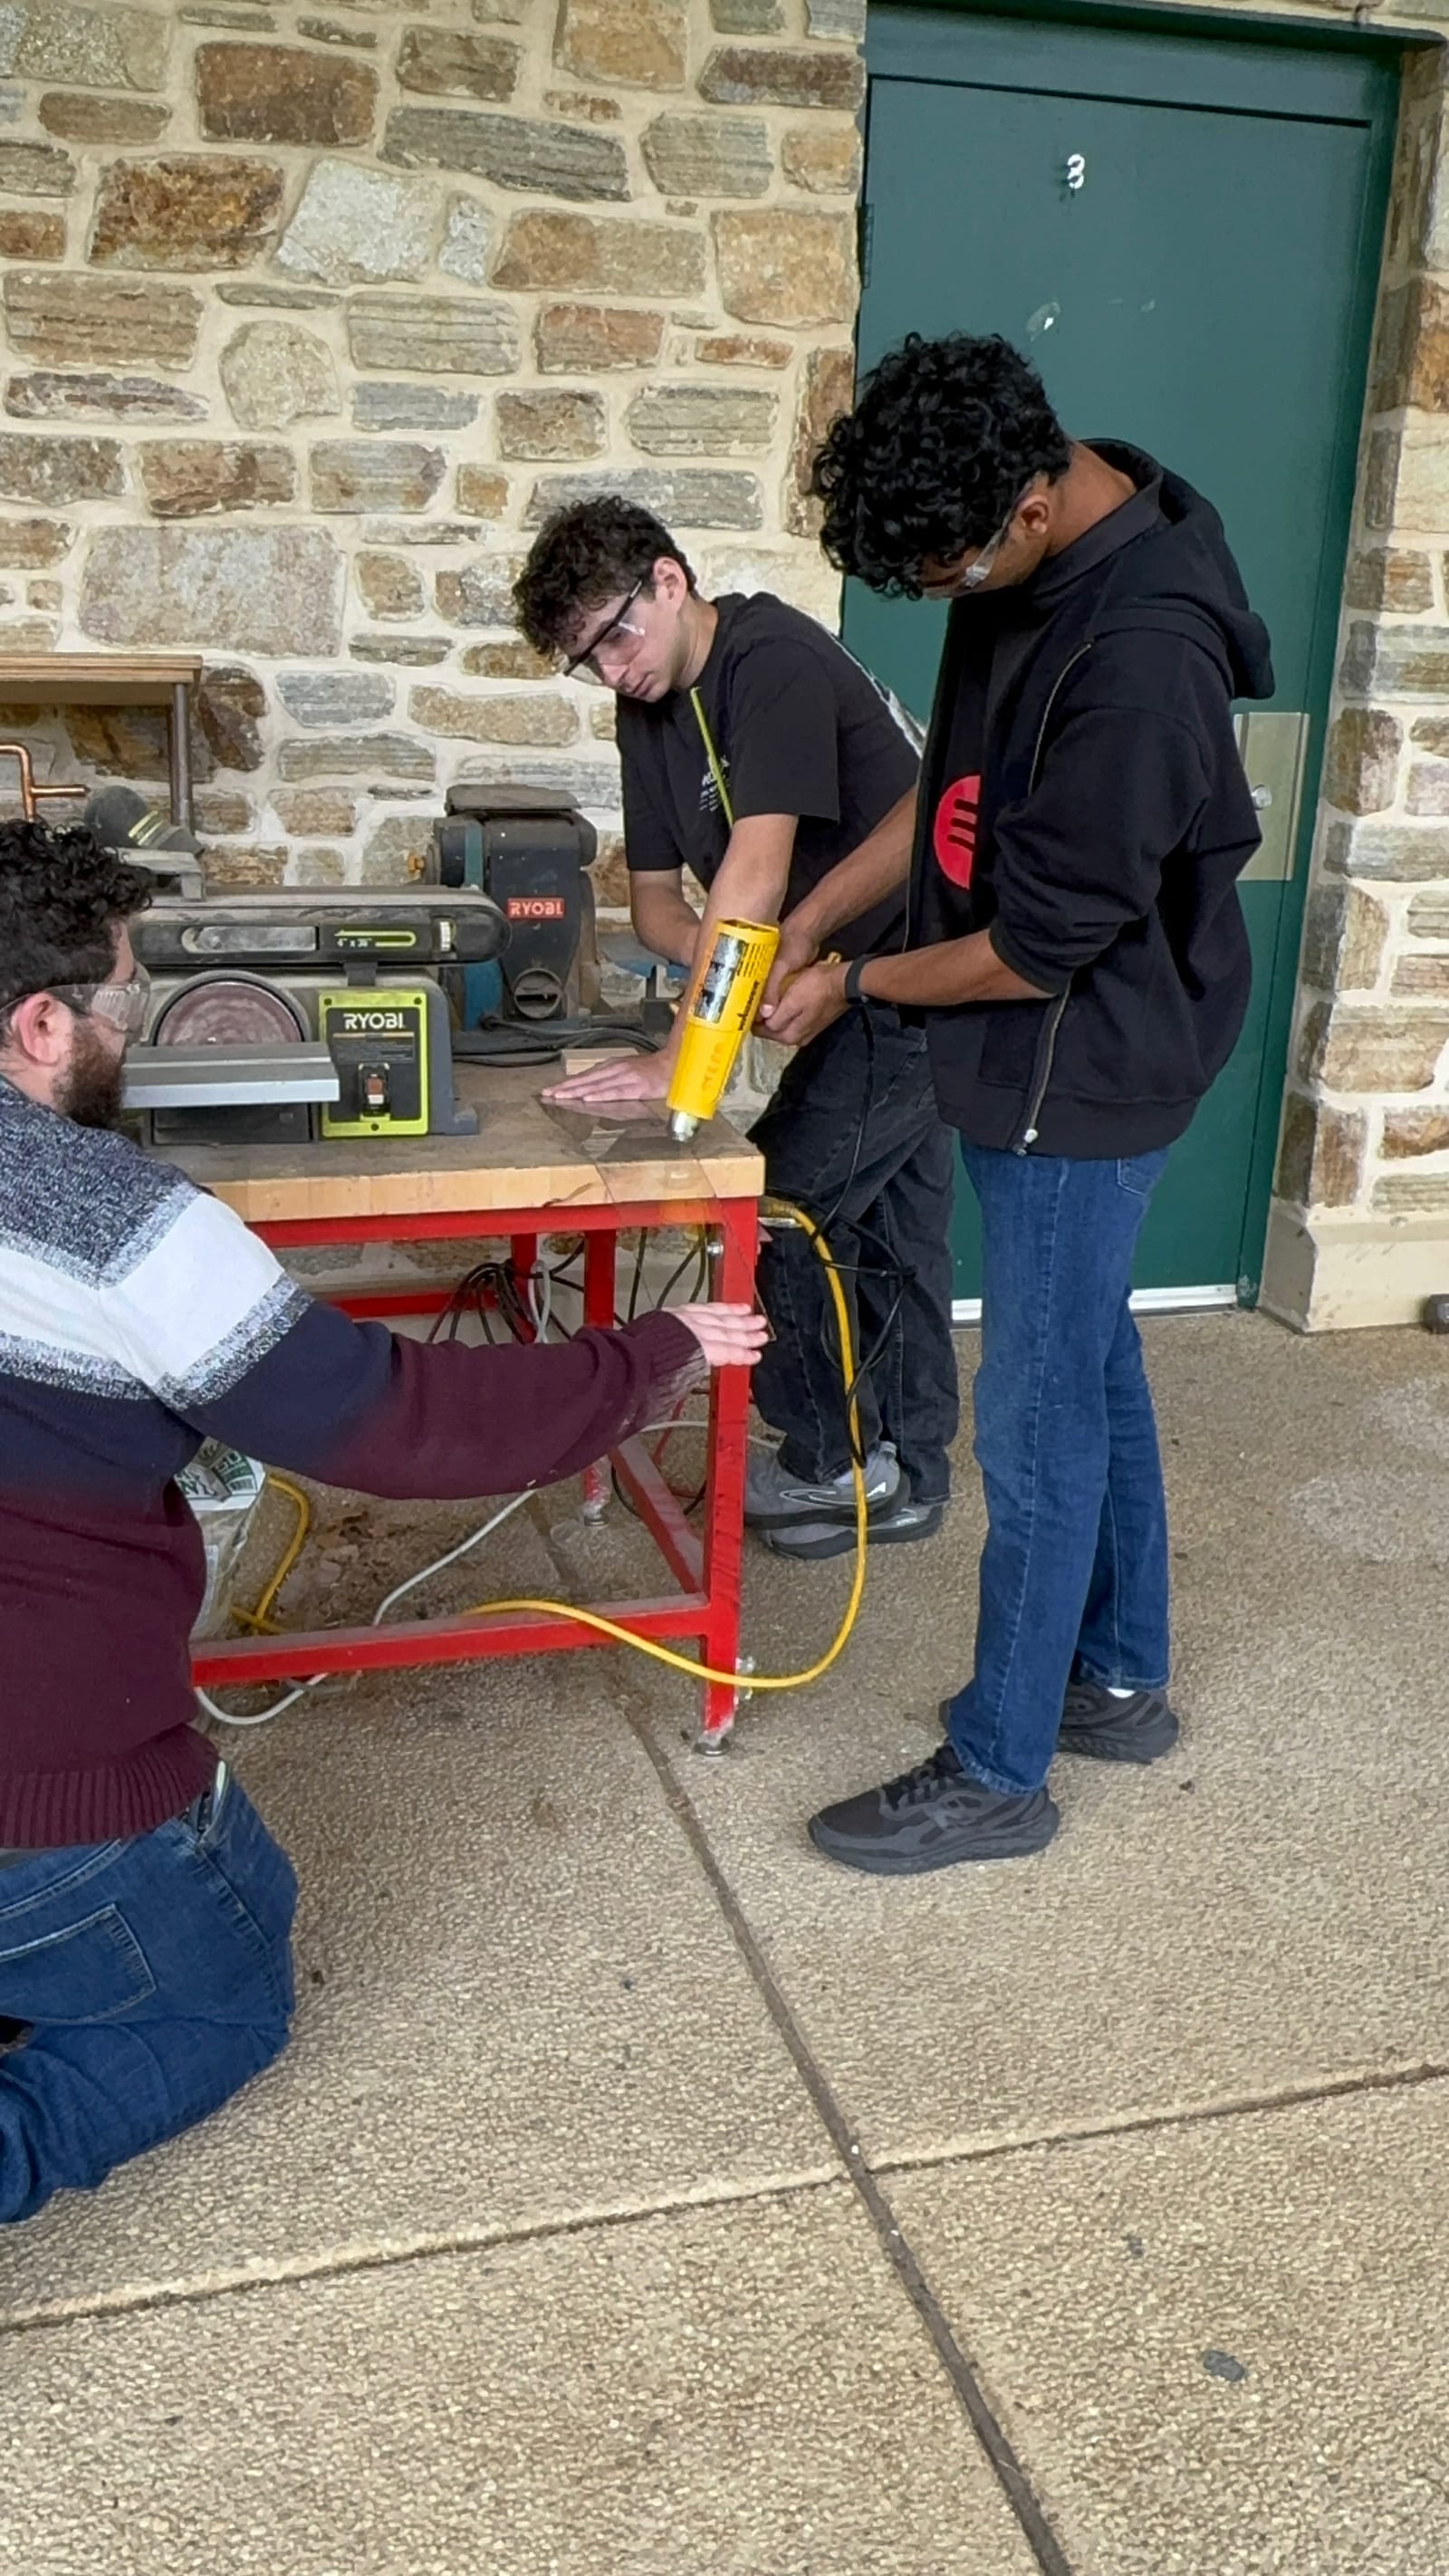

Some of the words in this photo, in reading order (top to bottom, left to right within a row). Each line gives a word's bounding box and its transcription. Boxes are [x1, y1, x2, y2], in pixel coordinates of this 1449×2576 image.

[1067, 153, 1085, 189] 3
[510, 901, 563, 915] RYOBI
[343, 1012, 404, 1030] RYOBI
